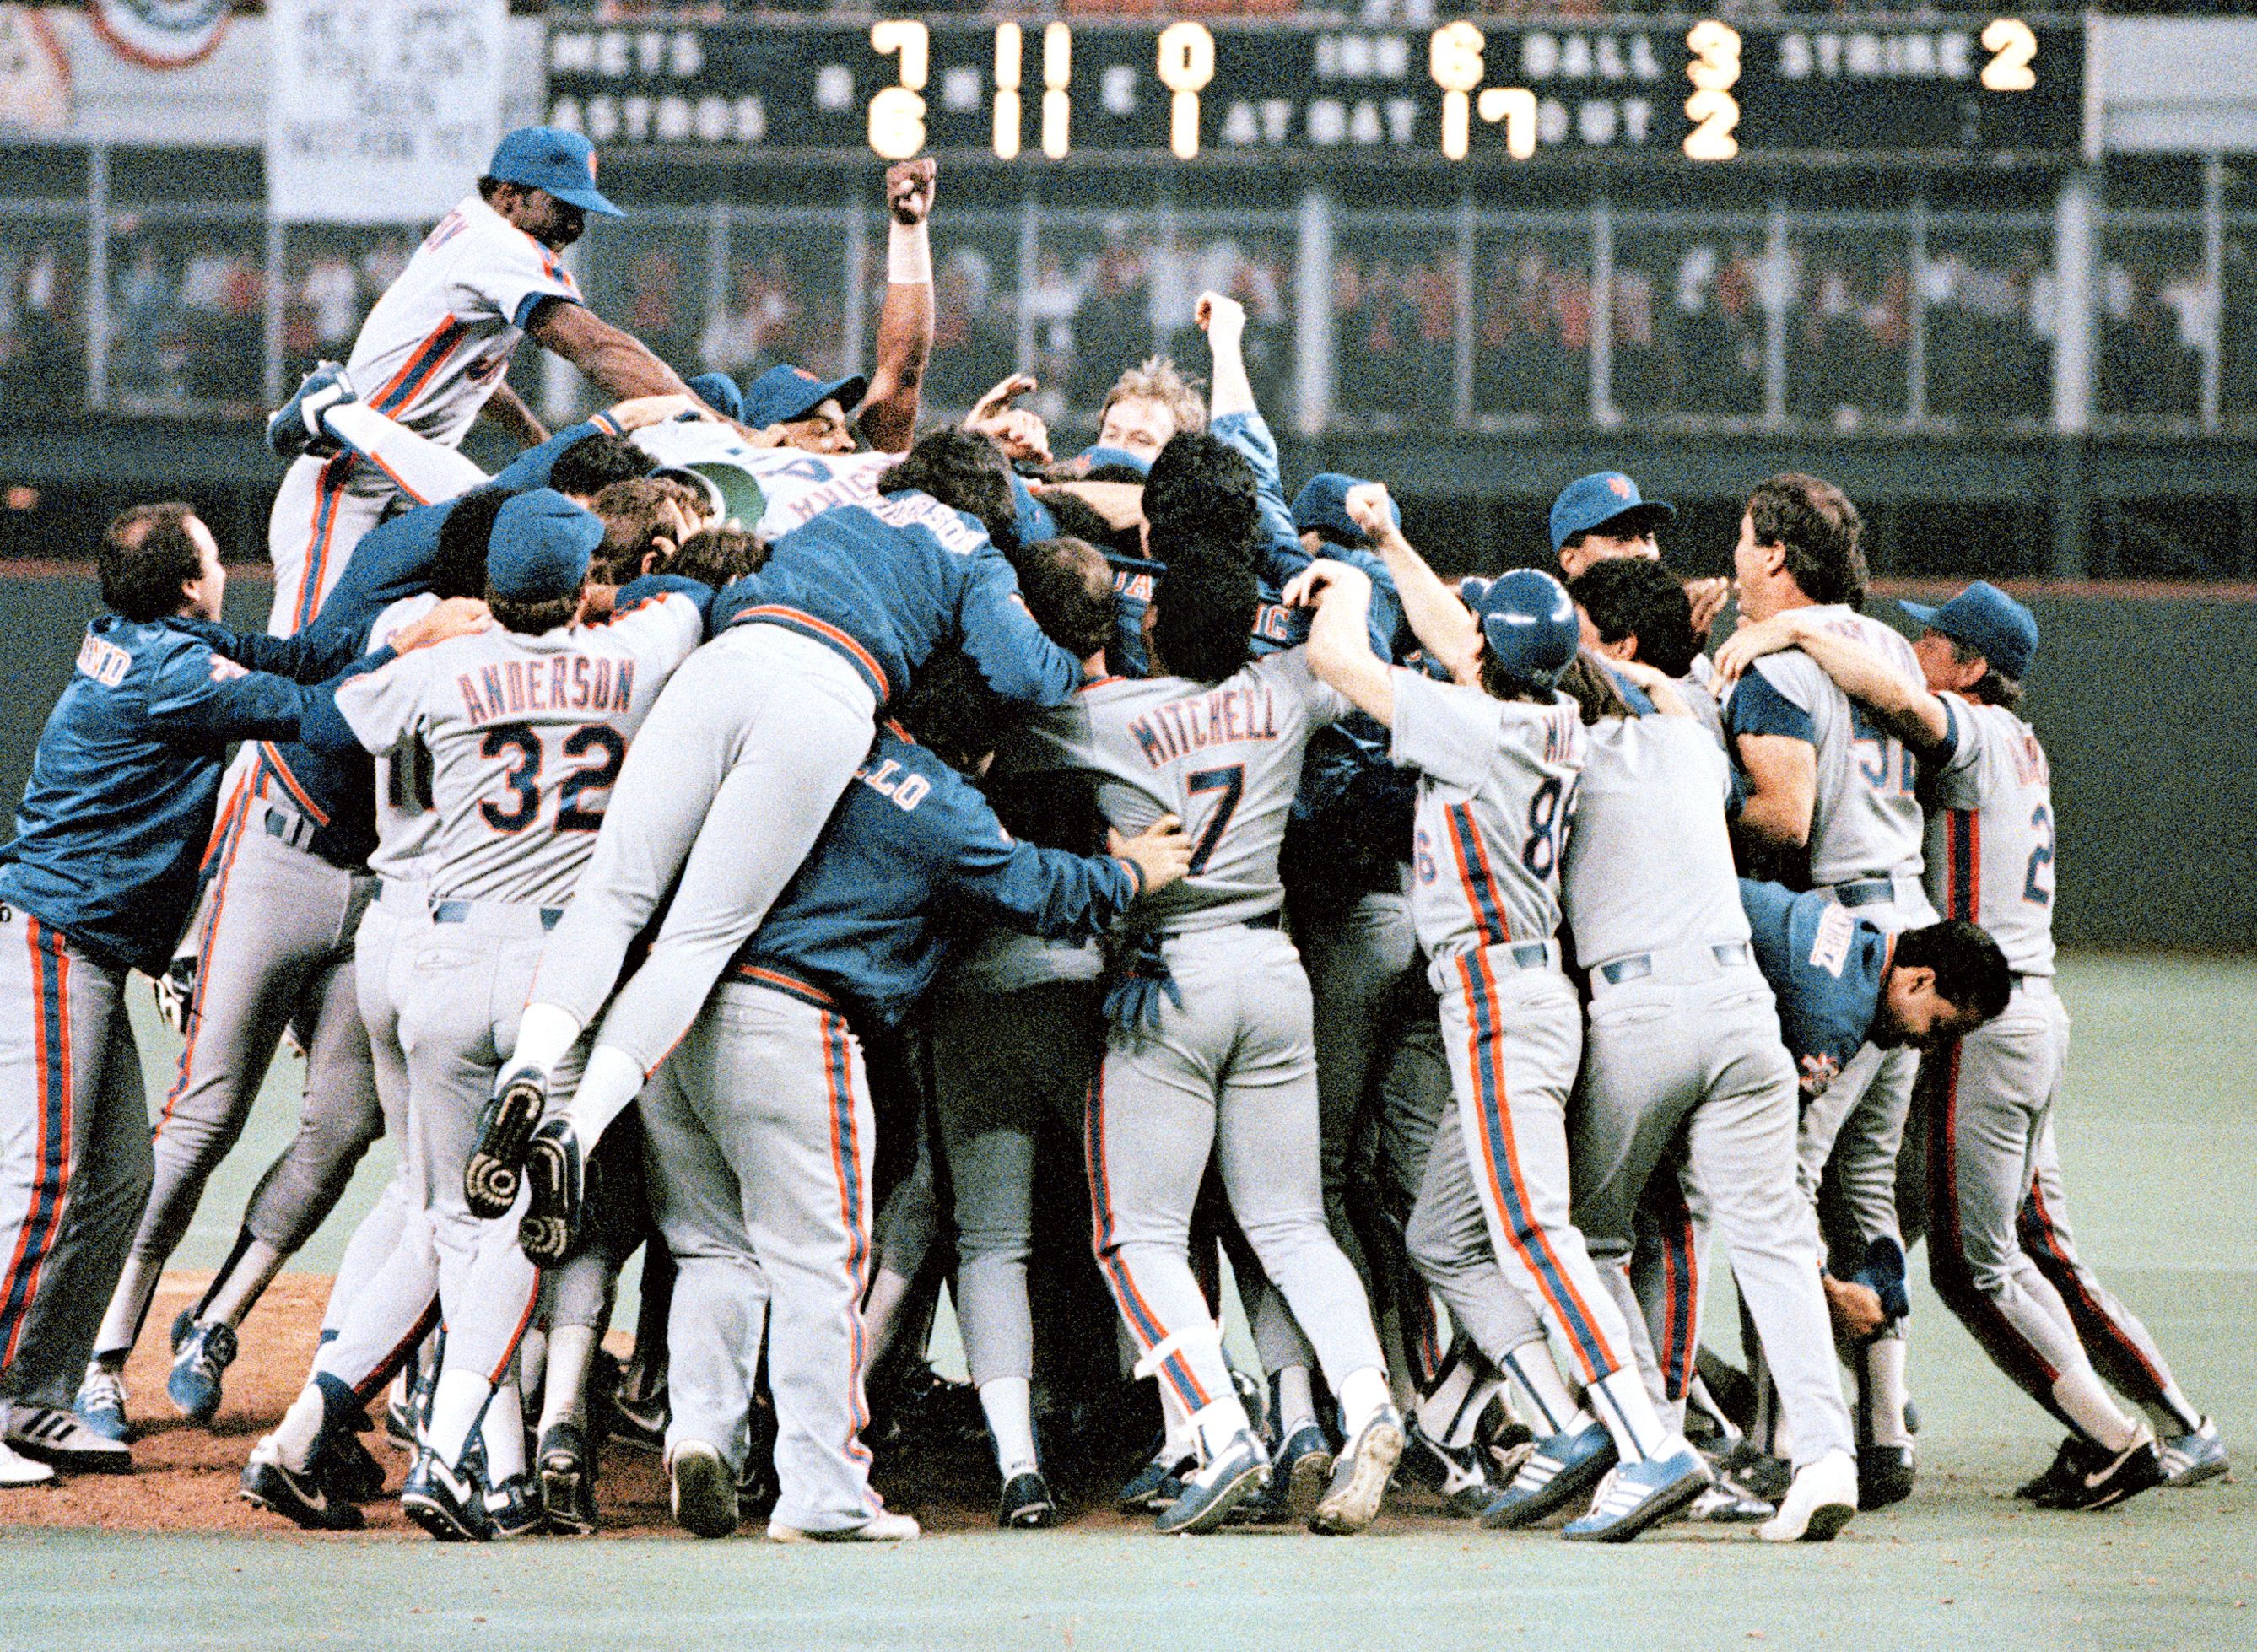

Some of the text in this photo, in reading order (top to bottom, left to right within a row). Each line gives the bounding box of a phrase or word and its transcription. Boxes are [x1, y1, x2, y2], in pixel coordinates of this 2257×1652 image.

[552, 31, 704, 77] METS
[871, 20, 928, 90] 7
[994, 21, 1072, 90] 11
[1158, 21, 1215, 90] 0
[1430, 20, 1485, 91] 6
[1521, 31, 1660, 80] BALL
[1686, 20, 1741, 89] 3
[1779, 31, 1972, 80] STRIKE
[1980, 19, 2038, 91] 2
[552, 94, 766, 142] ASTROS
[867, 86, 926, 159] 6
[992, 88, 1070, 160] 11
[1170, 89, 1200, 160] 1
[1442, 88, 1536, 160] 17
[1683, 88, 1740, 160] 2
[456, 655, 636, 725] ANDERSON
[1127, 688, 1279, 769] MITCHELL
[478, 721, 628, 834] 32
[1185, 763, 1246, 880] 7
